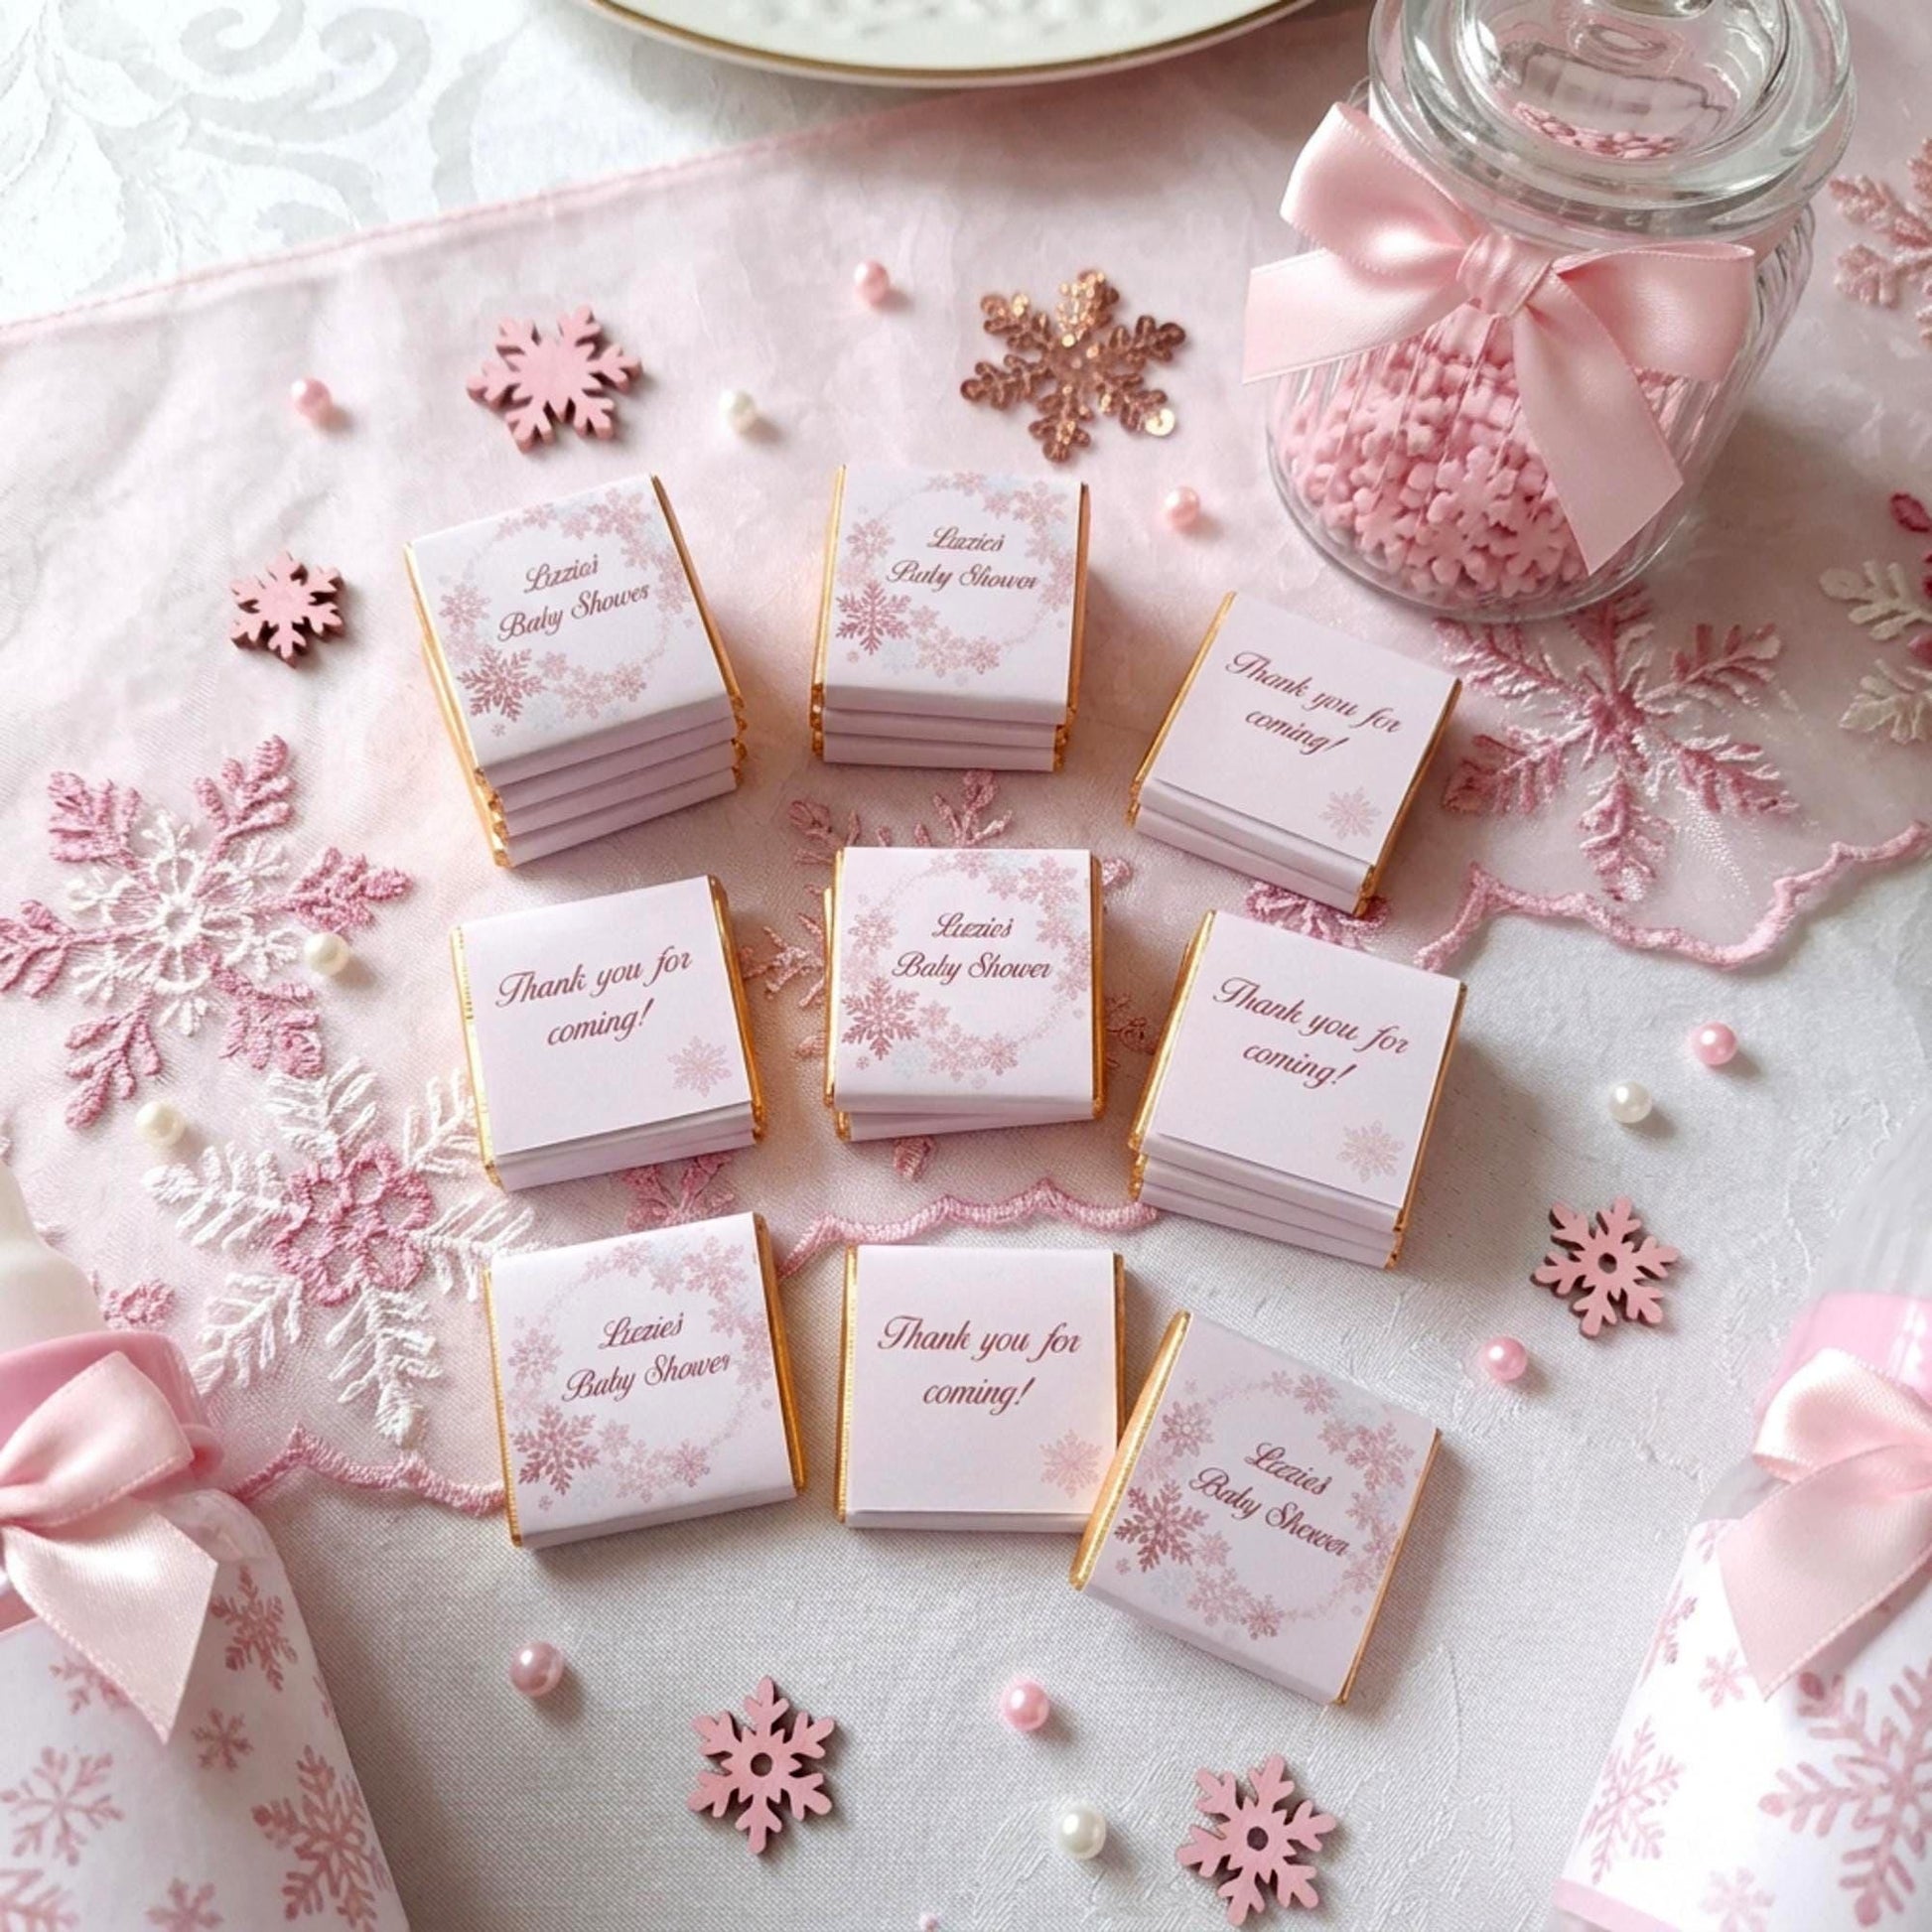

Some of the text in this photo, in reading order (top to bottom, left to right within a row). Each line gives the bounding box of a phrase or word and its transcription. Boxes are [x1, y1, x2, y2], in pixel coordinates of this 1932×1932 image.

[1225, 651, 1403, 733] Thank you for
[1245, 711, 1349, 756] coming!
[495, 945, 693, 1008] Thank you for
[892, 951, 1052, 986] Baby Shower
[548, 998, 654, 1045] coming!
[1212, 977, 1409, 1054] Thank you for
[1243, 1044, 1357, 1089] coming!
[878, 1315, 1082, 1362] Thank you for
[562, 1353, 731, 1402] Baby Shower
[922, 1376, 1035, 1416] coming!
